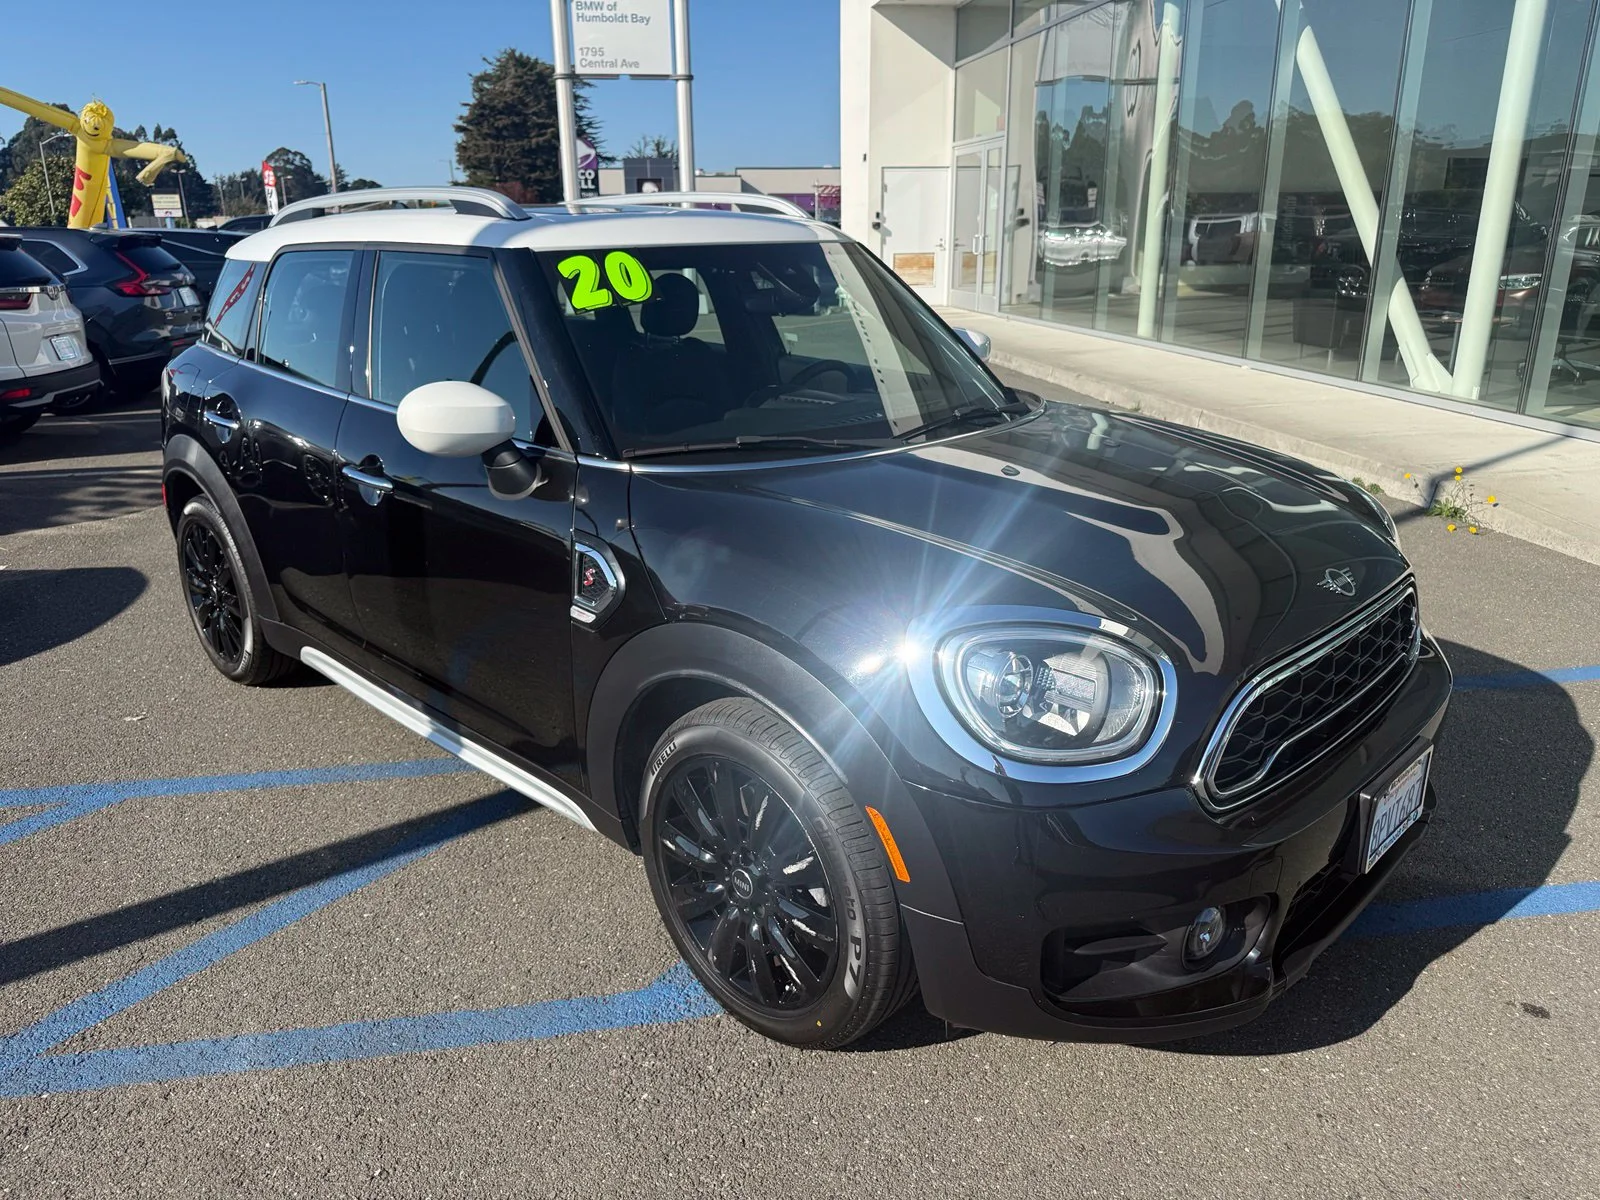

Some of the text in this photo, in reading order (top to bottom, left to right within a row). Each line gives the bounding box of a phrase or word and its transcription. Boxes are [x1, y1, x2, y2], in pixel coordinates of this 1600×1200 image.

[575, 1, 617, 11] BMW of
[576, 13, 651, 25] Humboldt Bay
[579, 47, 604, 57] 1795
[579, 58, 640, 68] Central Ave
[577, 169, 596, 180] CO
[580, 179, 596, 189] LL
[557, 251, 653, 310] 20
[849, 934, 863, 988] P7
